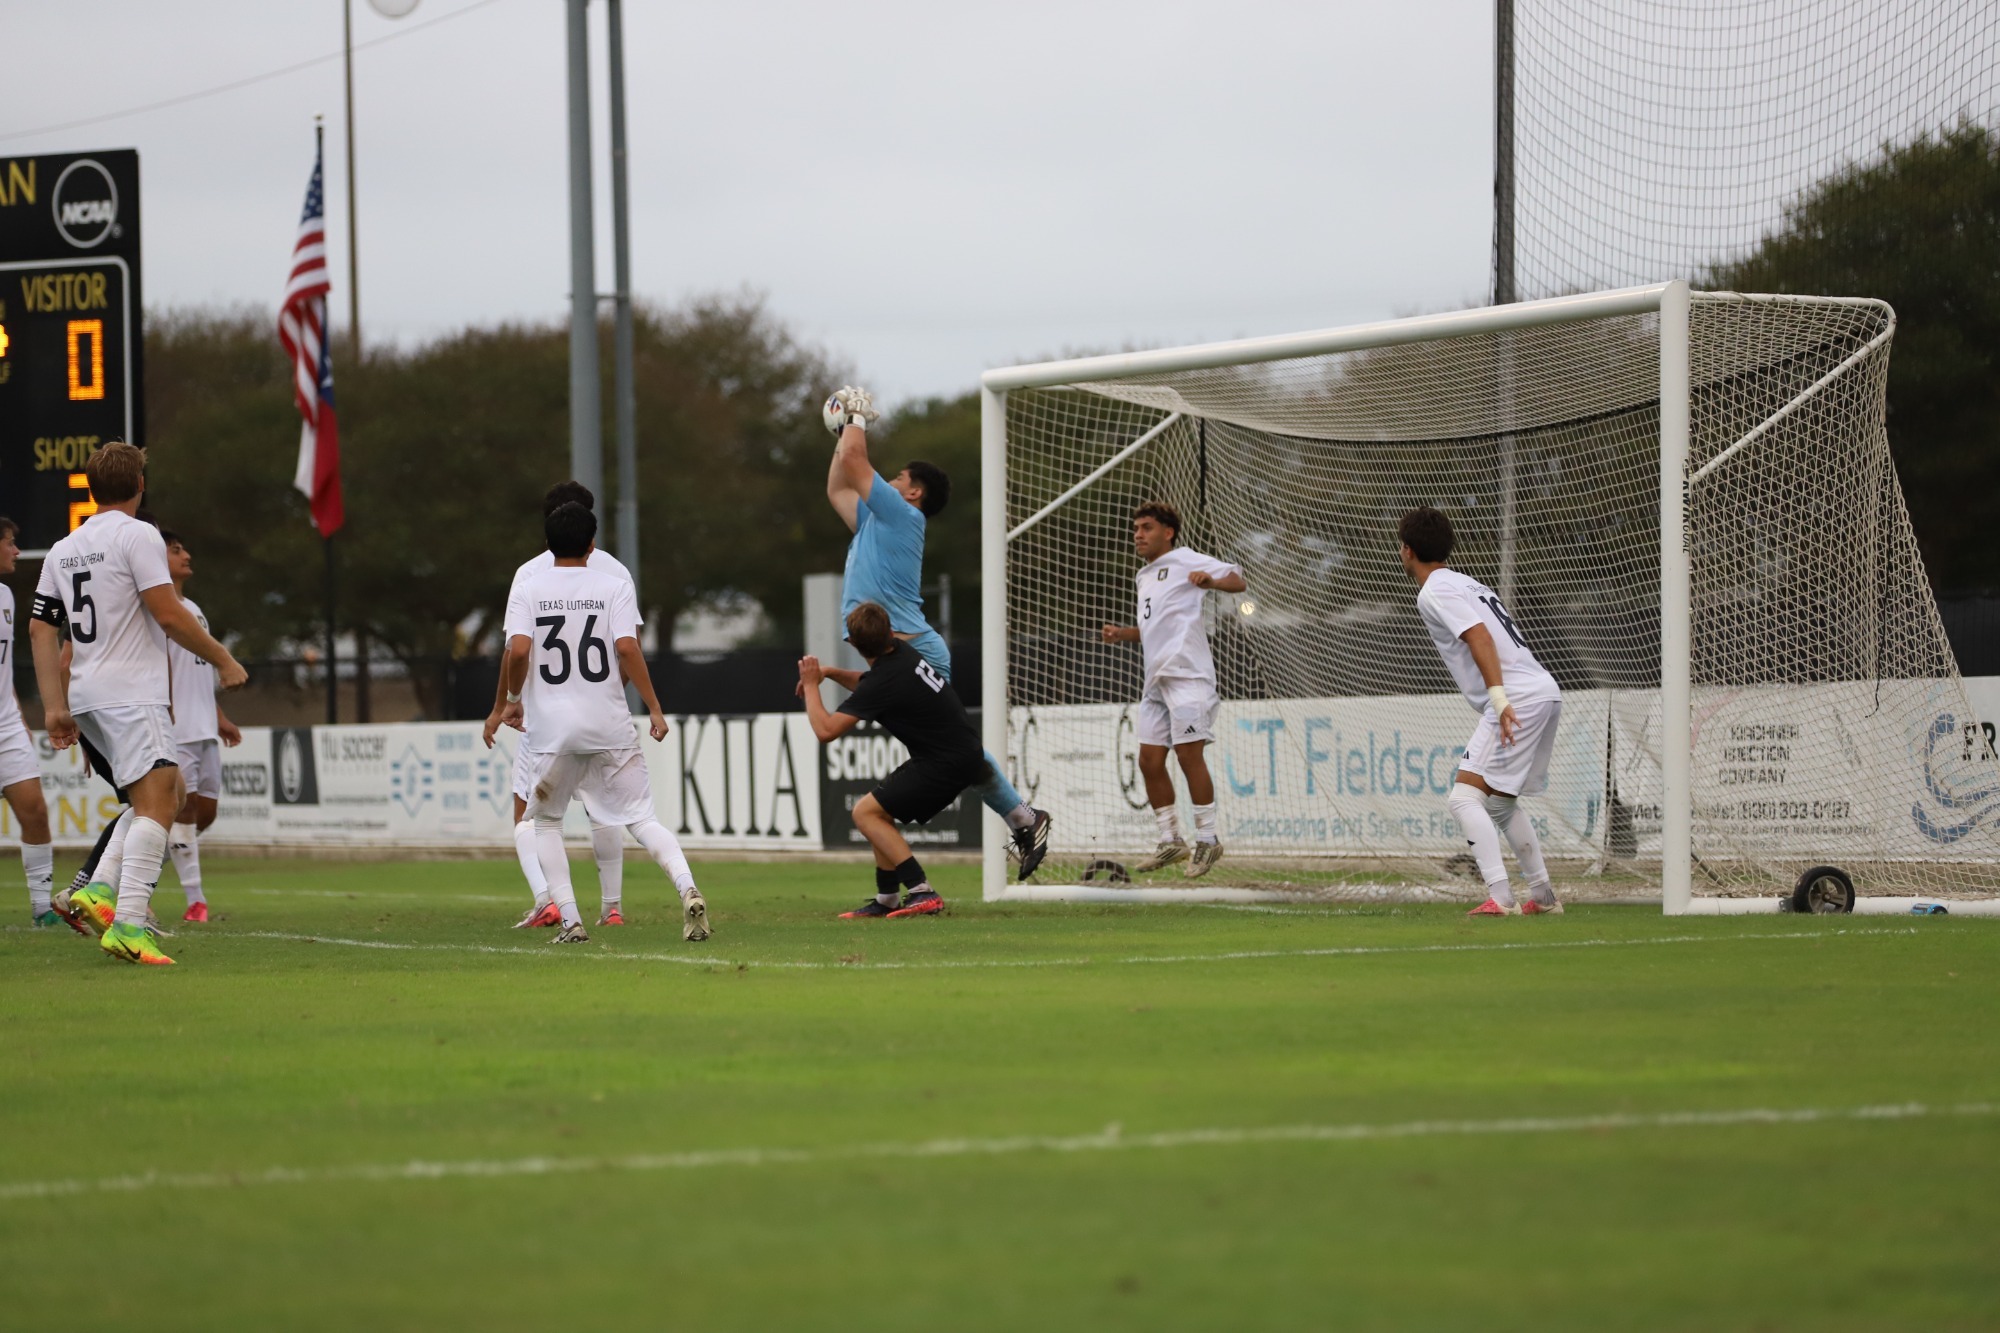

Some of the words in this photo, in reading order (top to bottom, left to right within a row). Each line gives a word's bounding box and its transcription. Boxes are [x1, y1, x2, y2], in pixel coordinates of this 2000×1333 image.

[62, 200, 113, 225] NCAA
[21, 272, 108, 312] VISITOR
[67, 319, 104, 400] 0
[71, 570, 97, 644] 5
[538, 600, 564, 612] TEXAS
[566, 600, 605, 611] LUTHERAN
[1143, 597, 1152, 620] 3
[535, 614, 611, 685] 36
[915, 659, 945, 693] 12
[827, 735, 911, 780] SCHOO
[1304, 716, 1467, 796] Fieldsc
[1226, 813, 1328, 841] Landscaping
